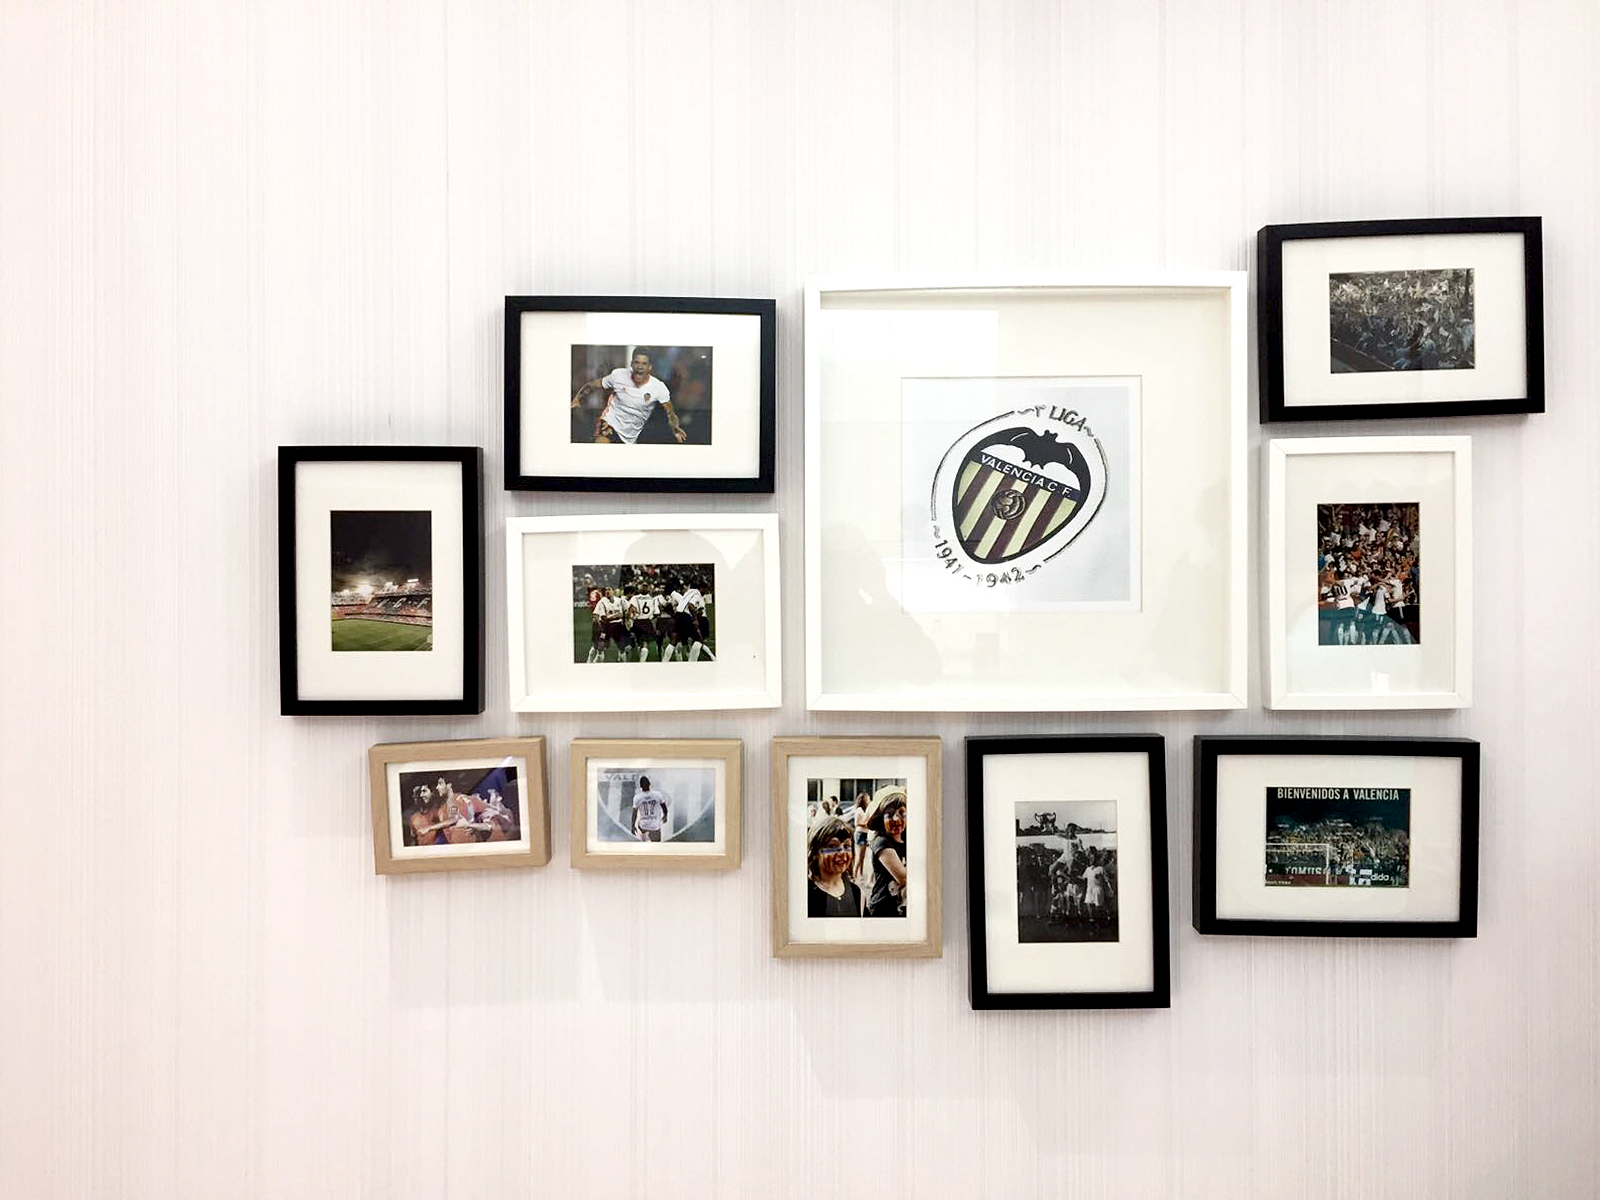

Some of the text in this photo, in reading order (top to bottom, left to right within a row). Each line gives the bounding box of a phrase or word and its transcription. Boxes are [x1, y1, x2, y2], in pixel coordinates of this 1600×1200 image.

[1049, 405, 1087, 432] LIGA
[980, 454, 1045, 487] VALENCIA
[641, 602, 650, 615] 6
[1277, 788, 1400, 801] BIENVENIDOS A VALENCIA
